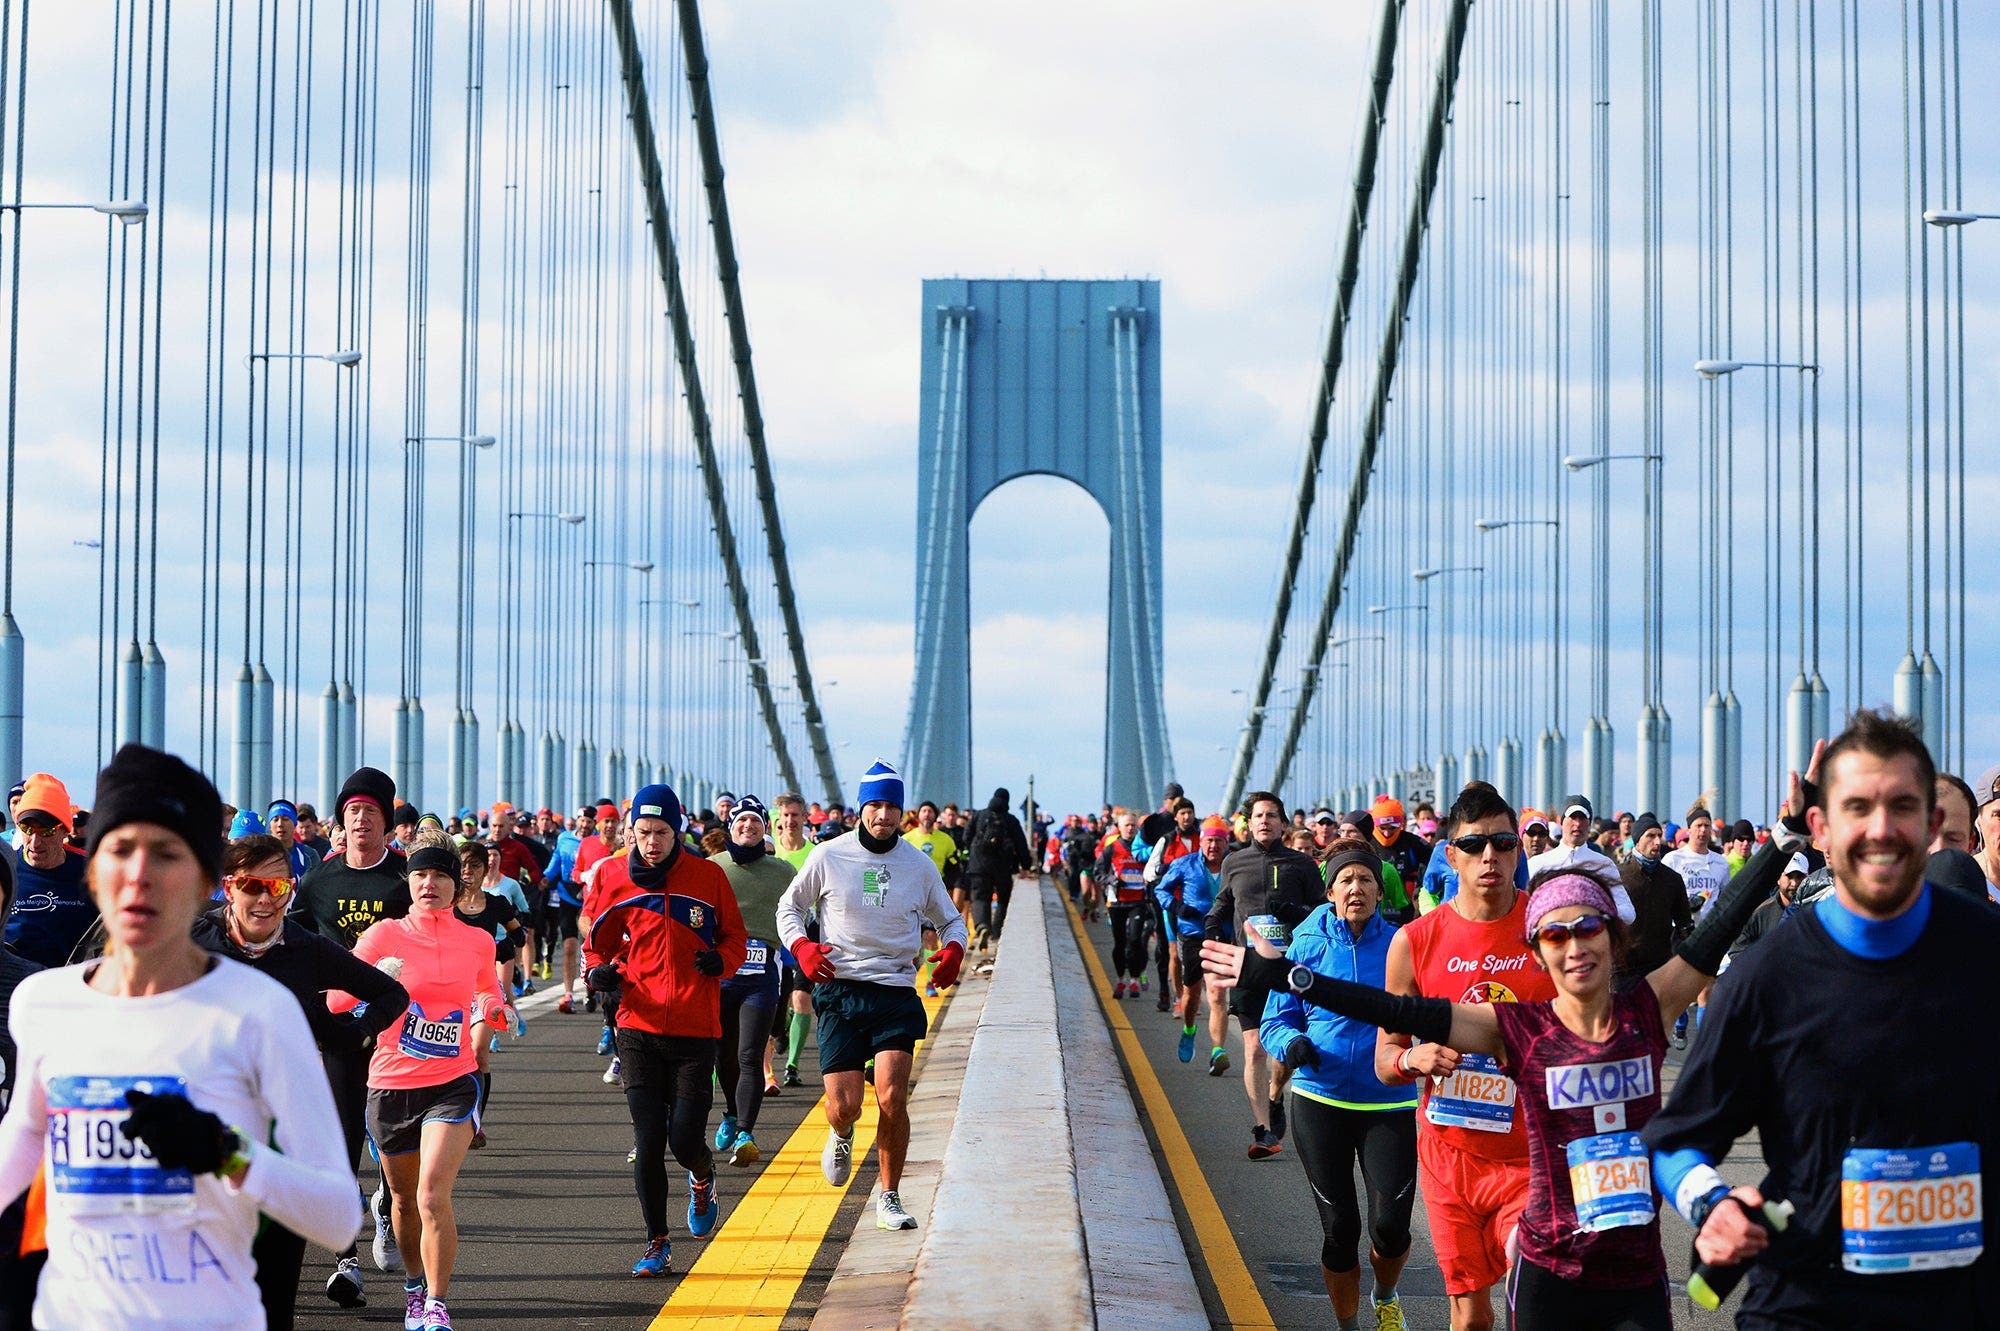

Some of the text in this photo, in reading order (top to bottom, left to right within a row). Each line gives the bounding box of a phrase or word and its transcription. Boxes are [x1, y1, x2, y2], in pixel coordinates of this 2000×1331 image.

[1409, 790, 1435, 804] 45
[337, 899, 383, 912] TEAM
[862, 896, 876, 906] 10K
[1447, 953, 1528, 975] One Spirit
[419, 1022, 457, 1043] 19645
[1453, 1074, 1507, 1102] 11823
[1550, 1058, 1651, 1107] KAORI
[1876, 1181, 1975, 1225] 26083
[70, 1230, 231, 1284] SHEILA
